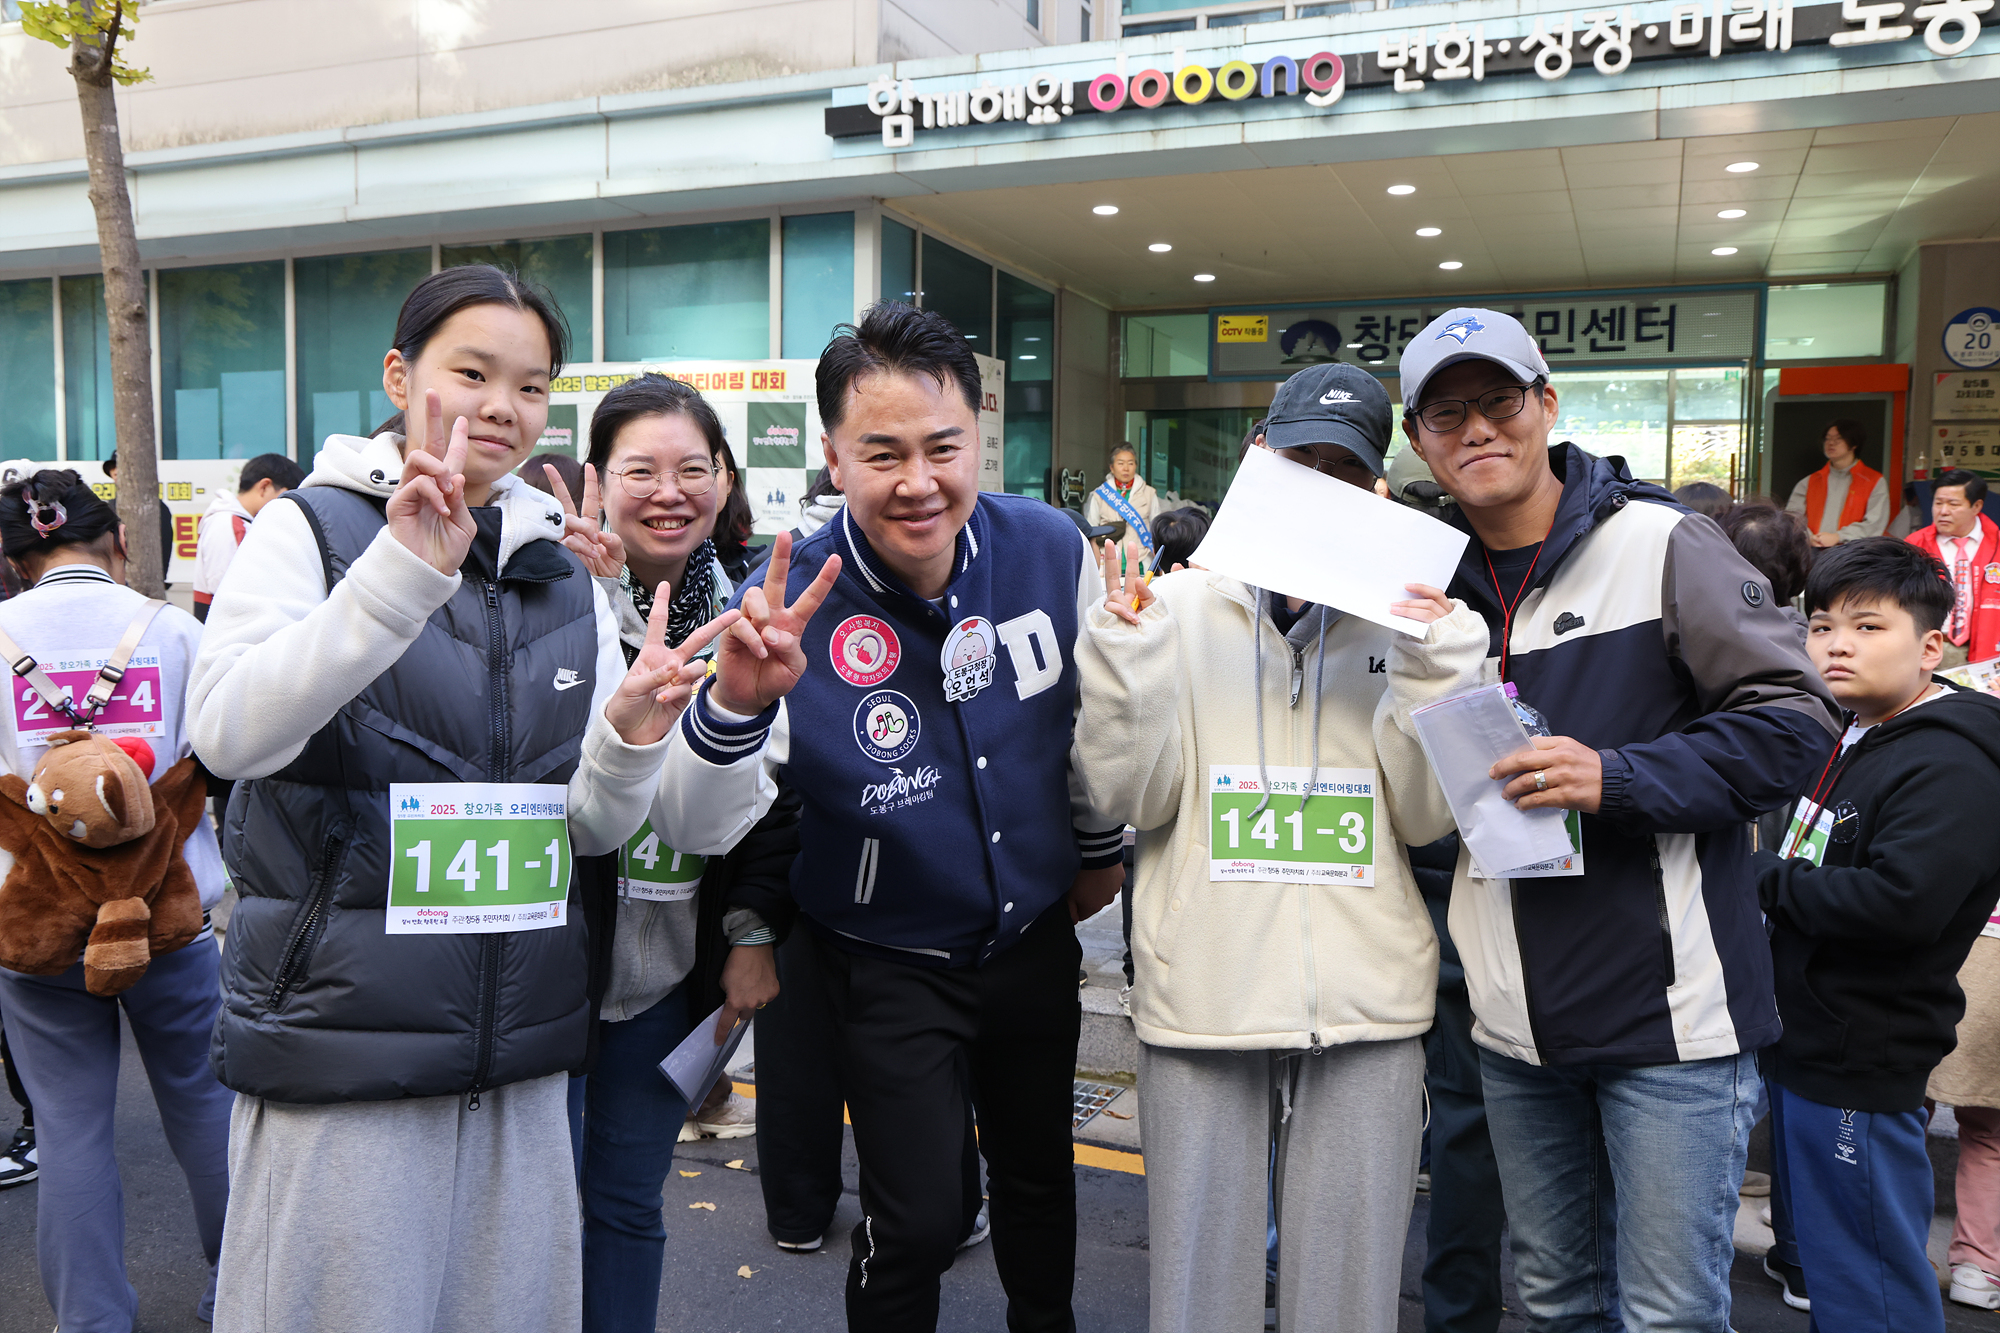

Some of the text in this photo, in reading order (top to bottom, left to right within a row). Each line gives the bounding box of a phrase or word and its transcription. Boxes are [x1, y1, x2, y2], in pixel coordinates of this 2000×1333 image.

[867, 72, 1074, 148] 함께해요!
[1088, 46, 1346, 108] dobong
[1222, 328, 1243, 336] CCTV
[1507, 303, 1676, 355] 민센터
[1964, 332, 1991, 350] 20
[751, 371, 786, 391] 대회
[1326, 388, 1354, 400] NIKE
[168, 483, 192, 499] 대회
[996, 608, 1064, 701] D
[59, 659, 91, 670] 창오가족
[953, 659, 988, 680] 도봉구청장
[557, 667, 579, 683] NIKE
[866, 694, 893, 709] SEOUL
[865, 728, 917, 759] DOBONG SOCKS
[861, 765, 935, 808] DOBONG
[1238, 780, 1260, 790] 2025.
[430, 802, 565, 816] 2025. 창오가족 오리엔티어링대회
[869, 789, 934, 816] 도봉구 브레이킹팀
[1220, 807, 1367, 854] 141-3
[405, 838, 560, 893] 141-1
[417, 908, 449, 917] dobong
[483, 913, 510, 923] 주민자치회
